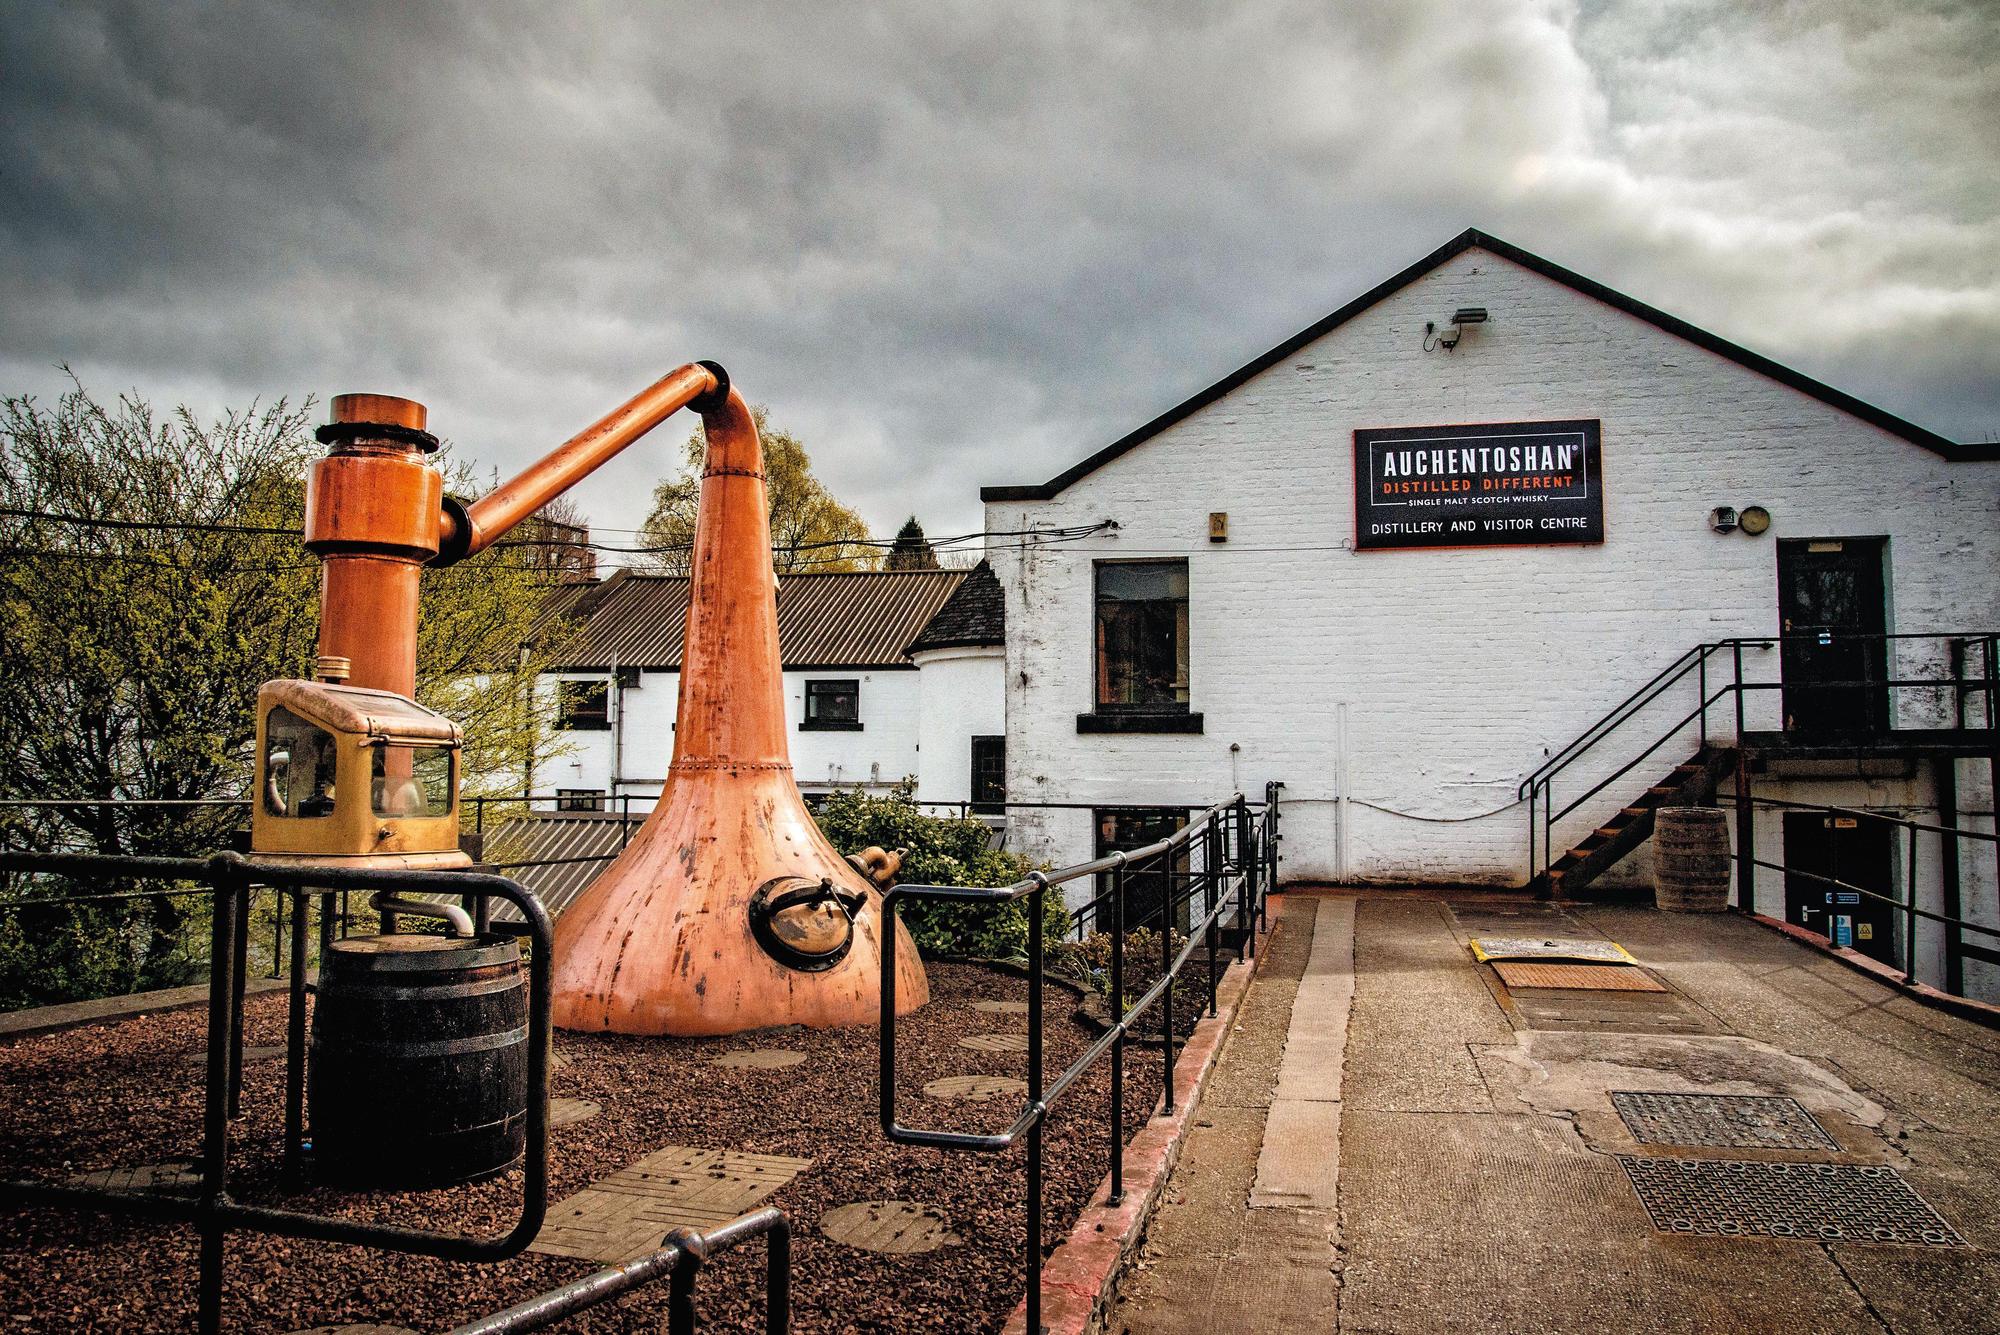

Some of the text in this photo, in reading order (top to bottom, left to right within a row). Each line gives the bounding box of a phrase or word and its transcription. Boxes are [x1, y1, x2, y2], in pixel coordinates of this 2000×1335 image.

[1383, 476, 1573, 494] DISTILLED DIFFERENT
[1409, 495, 1548, 507] SINGLE MALT SCOTCH WHISKY
[1372, 517, 1588, 535] DISTILLERY AND VISITOR CENTRE
